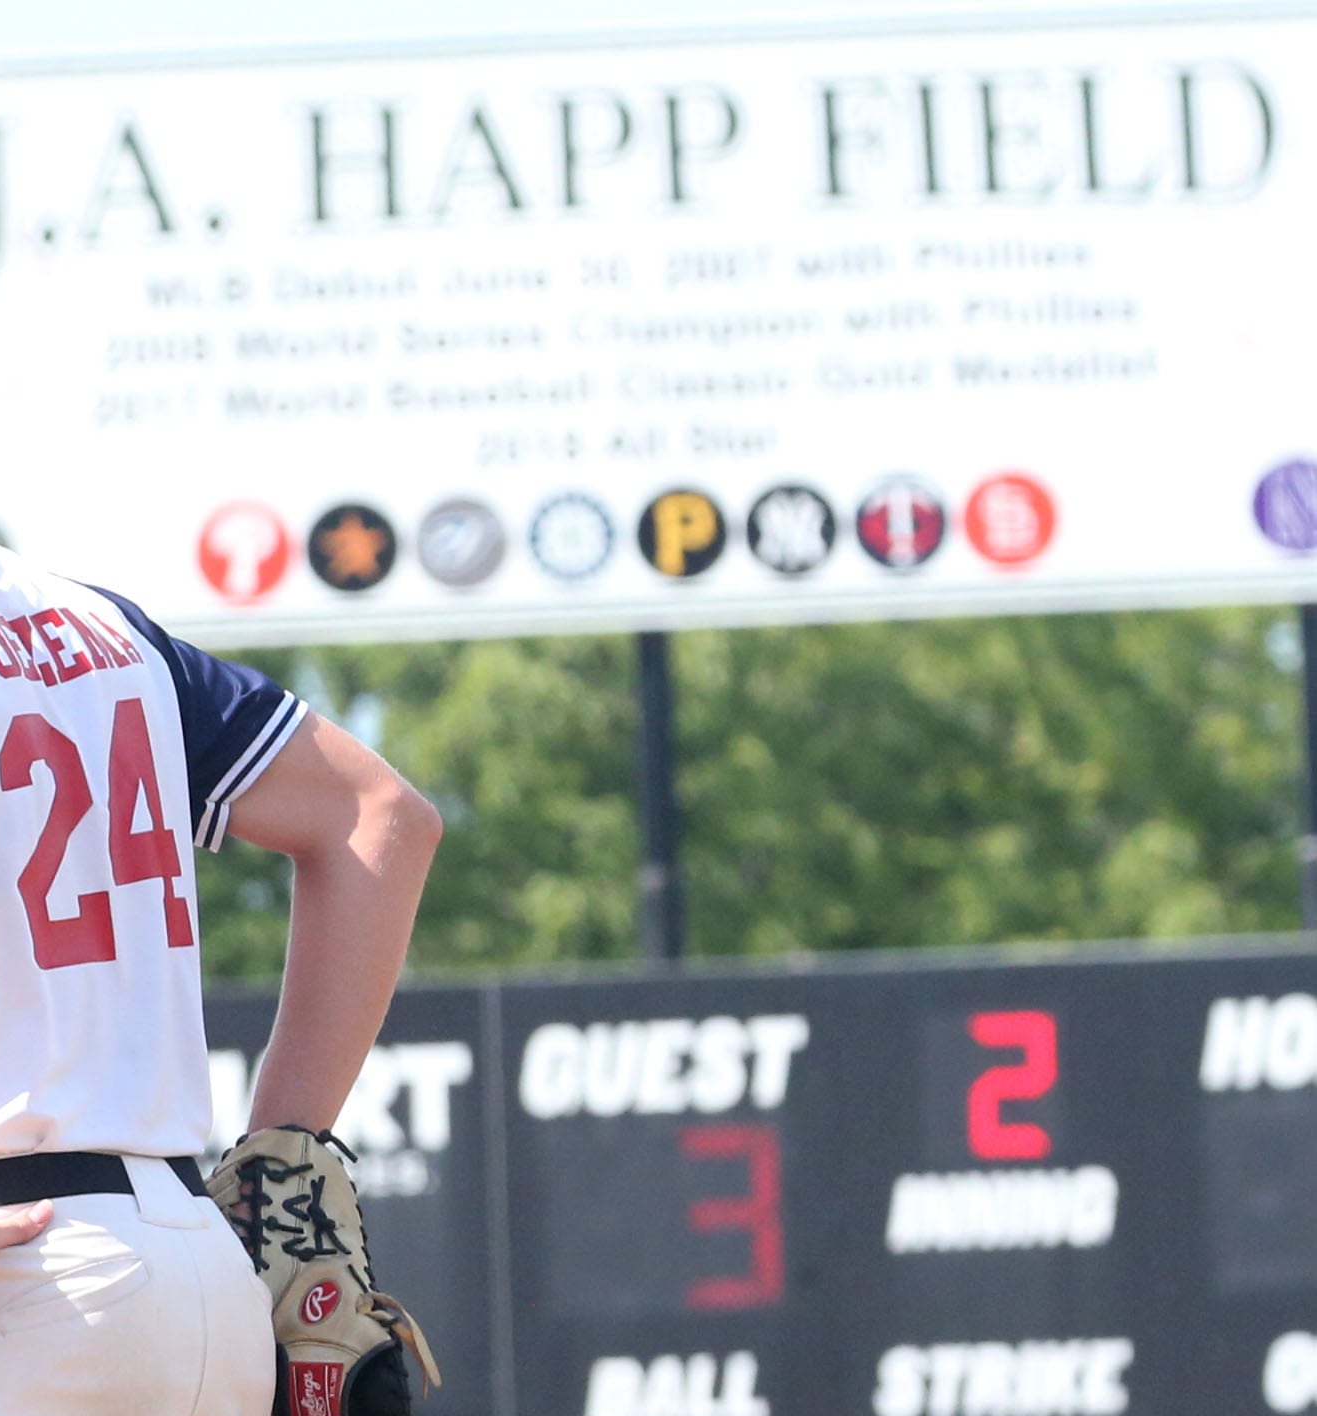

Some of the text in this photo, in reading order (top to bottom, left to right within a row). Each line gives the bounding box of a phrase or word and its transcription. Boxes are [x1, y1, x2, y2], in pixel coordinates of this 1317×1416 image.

[292, 80, 743, 226] HAPP
[804, 58, 1276, 203] FIELD
[519, 1013, 810, 1119] GUEST
[967, 1009, 1058, 1160] 2
[679, 1124, 784, 1310] 3
[886, 1164, 1119, 1254] INNING
